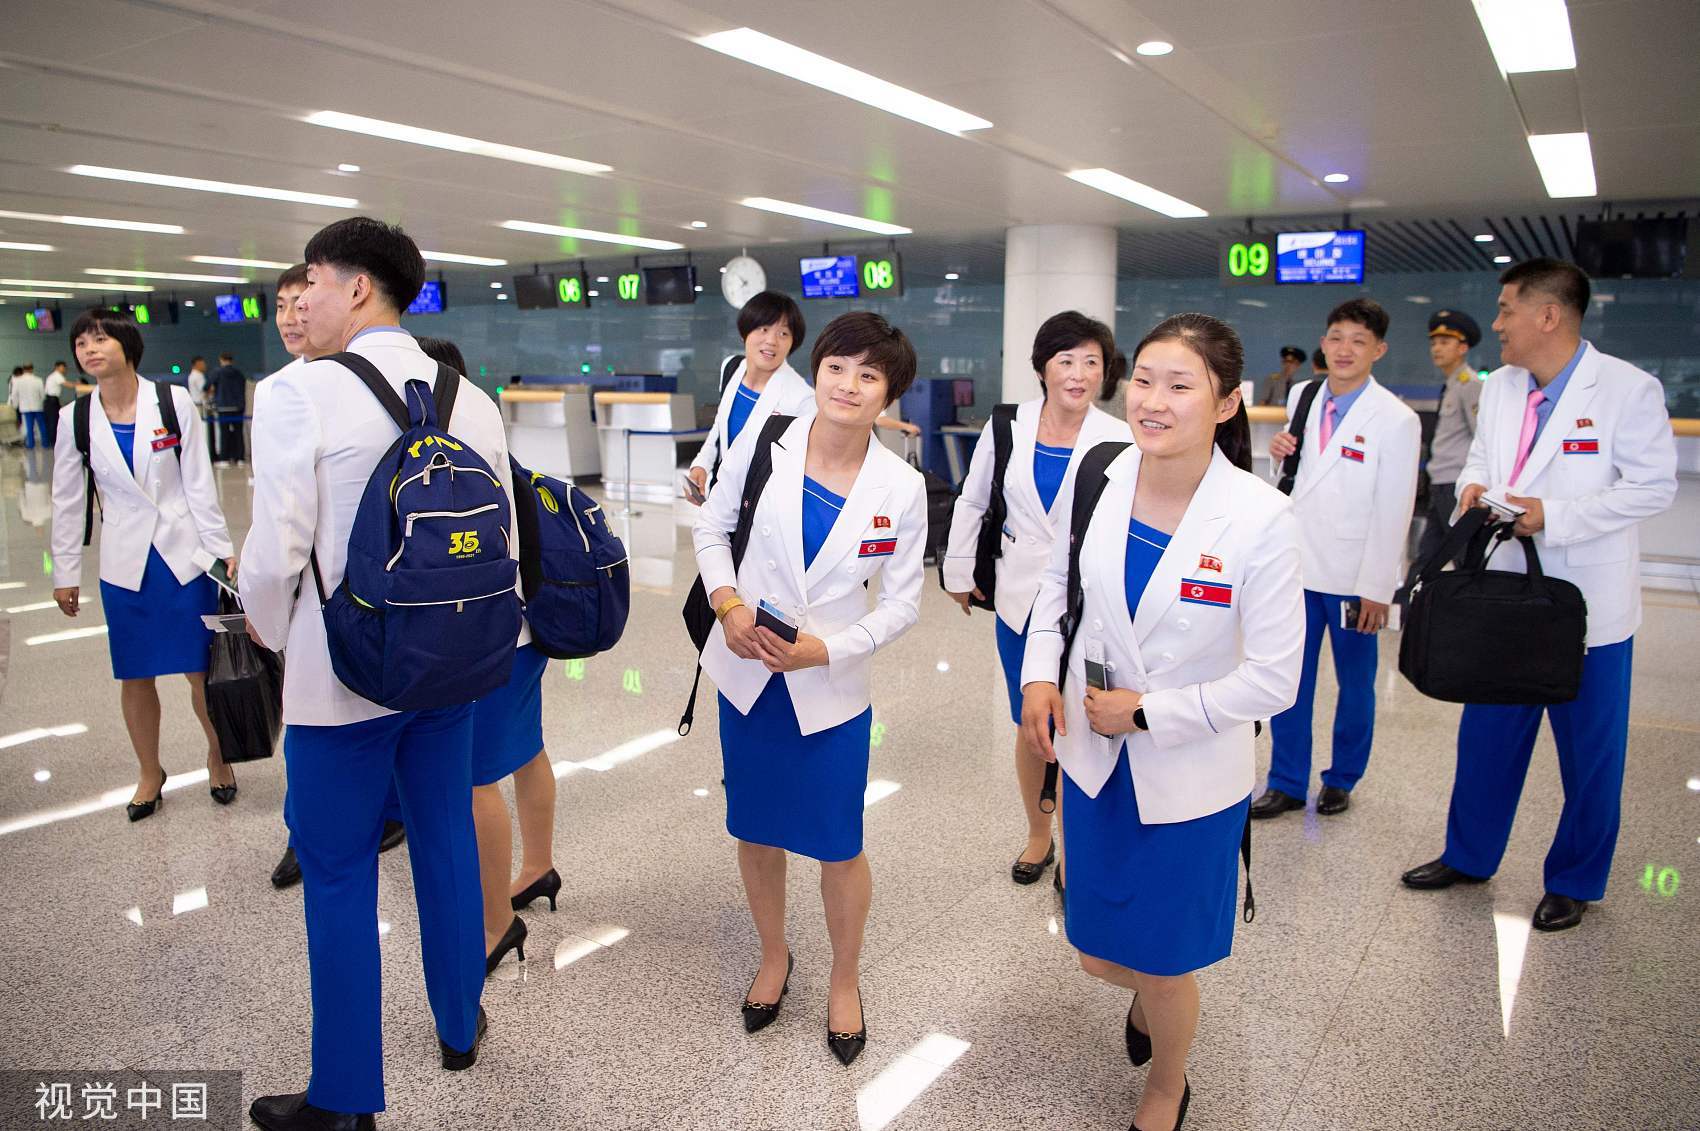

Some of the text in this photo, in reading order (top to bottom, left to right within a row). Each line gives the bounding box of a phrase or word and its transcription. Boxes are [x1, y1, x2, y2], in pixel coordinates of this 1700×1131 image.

[1229, 243, 1269, 277] 09
[618, 274, 640, 300] 07
[863, 260, 894, 289] 08
[559, 278, 581, 302] 06
